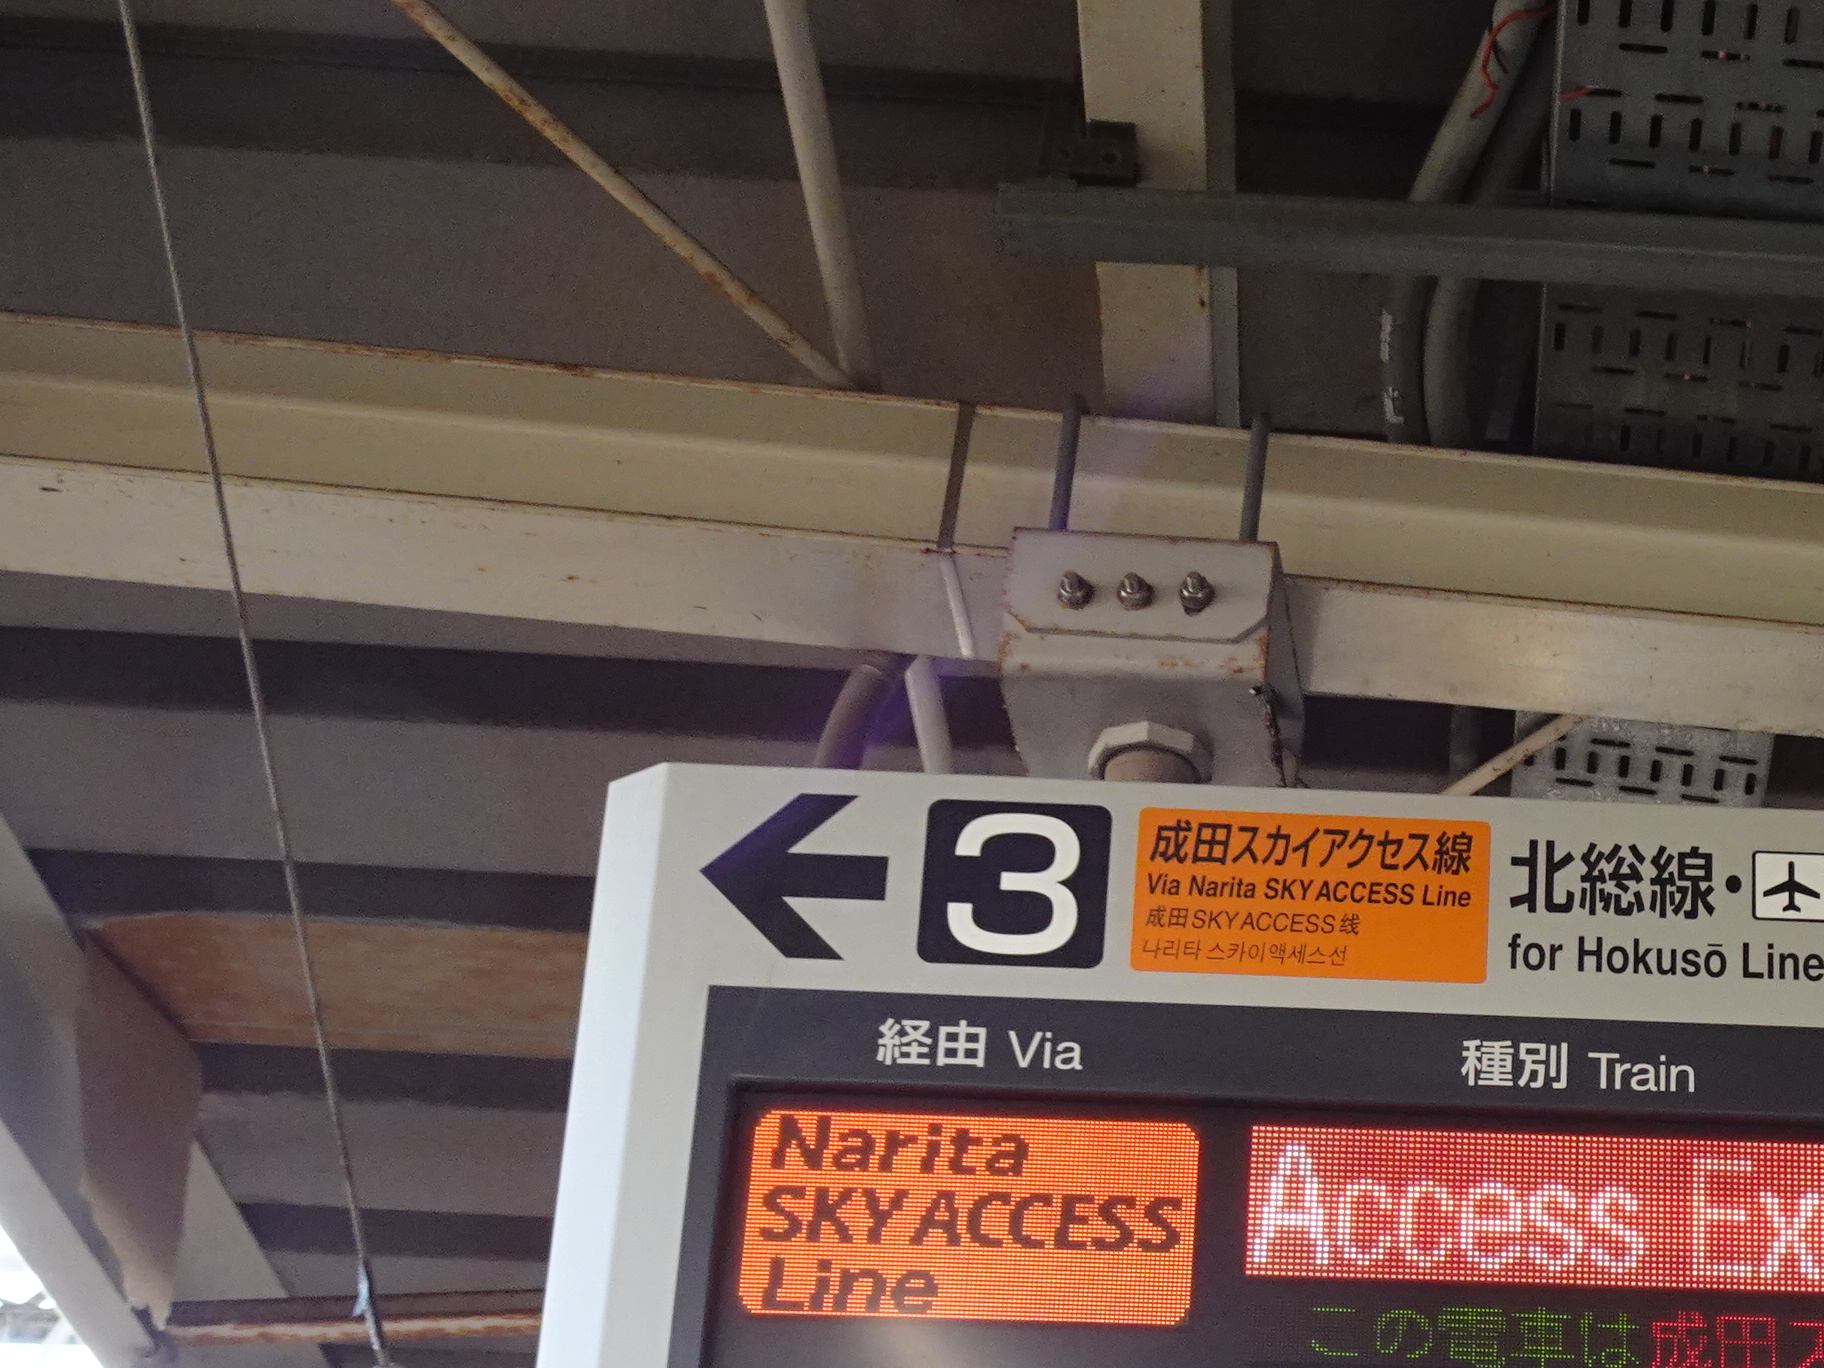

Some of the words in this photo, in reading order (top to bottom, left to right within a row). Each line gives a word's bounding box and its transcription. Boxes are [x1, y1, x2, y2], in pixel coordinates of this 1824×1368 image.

[1150, 819, 1474, 875] 成田スカイアクセス線
[946, 812, 1082, 956] 3
[1147, 873, 1181, 896] Via
[1188, 875, 1256, 899] Narita
[1422, 884, 1472, 908] Line
[1508, 933, 1563, 972] for
[1577, 936, 1728, 979] Hokusō
[1742, 942, 1824, 982] Line
[876, 1016, 987, 1068] 経由
[1007, 1029, 1084, 1072] Via
[1460, 1040, 1569, 1090] 種別
[1588, 1051, 1696, 1093] Train
[771, 1113, 1030, 1178] Narita
[1251, 1140, 1647, 1274] Access
[761, 1256, 938, 1315] Line
